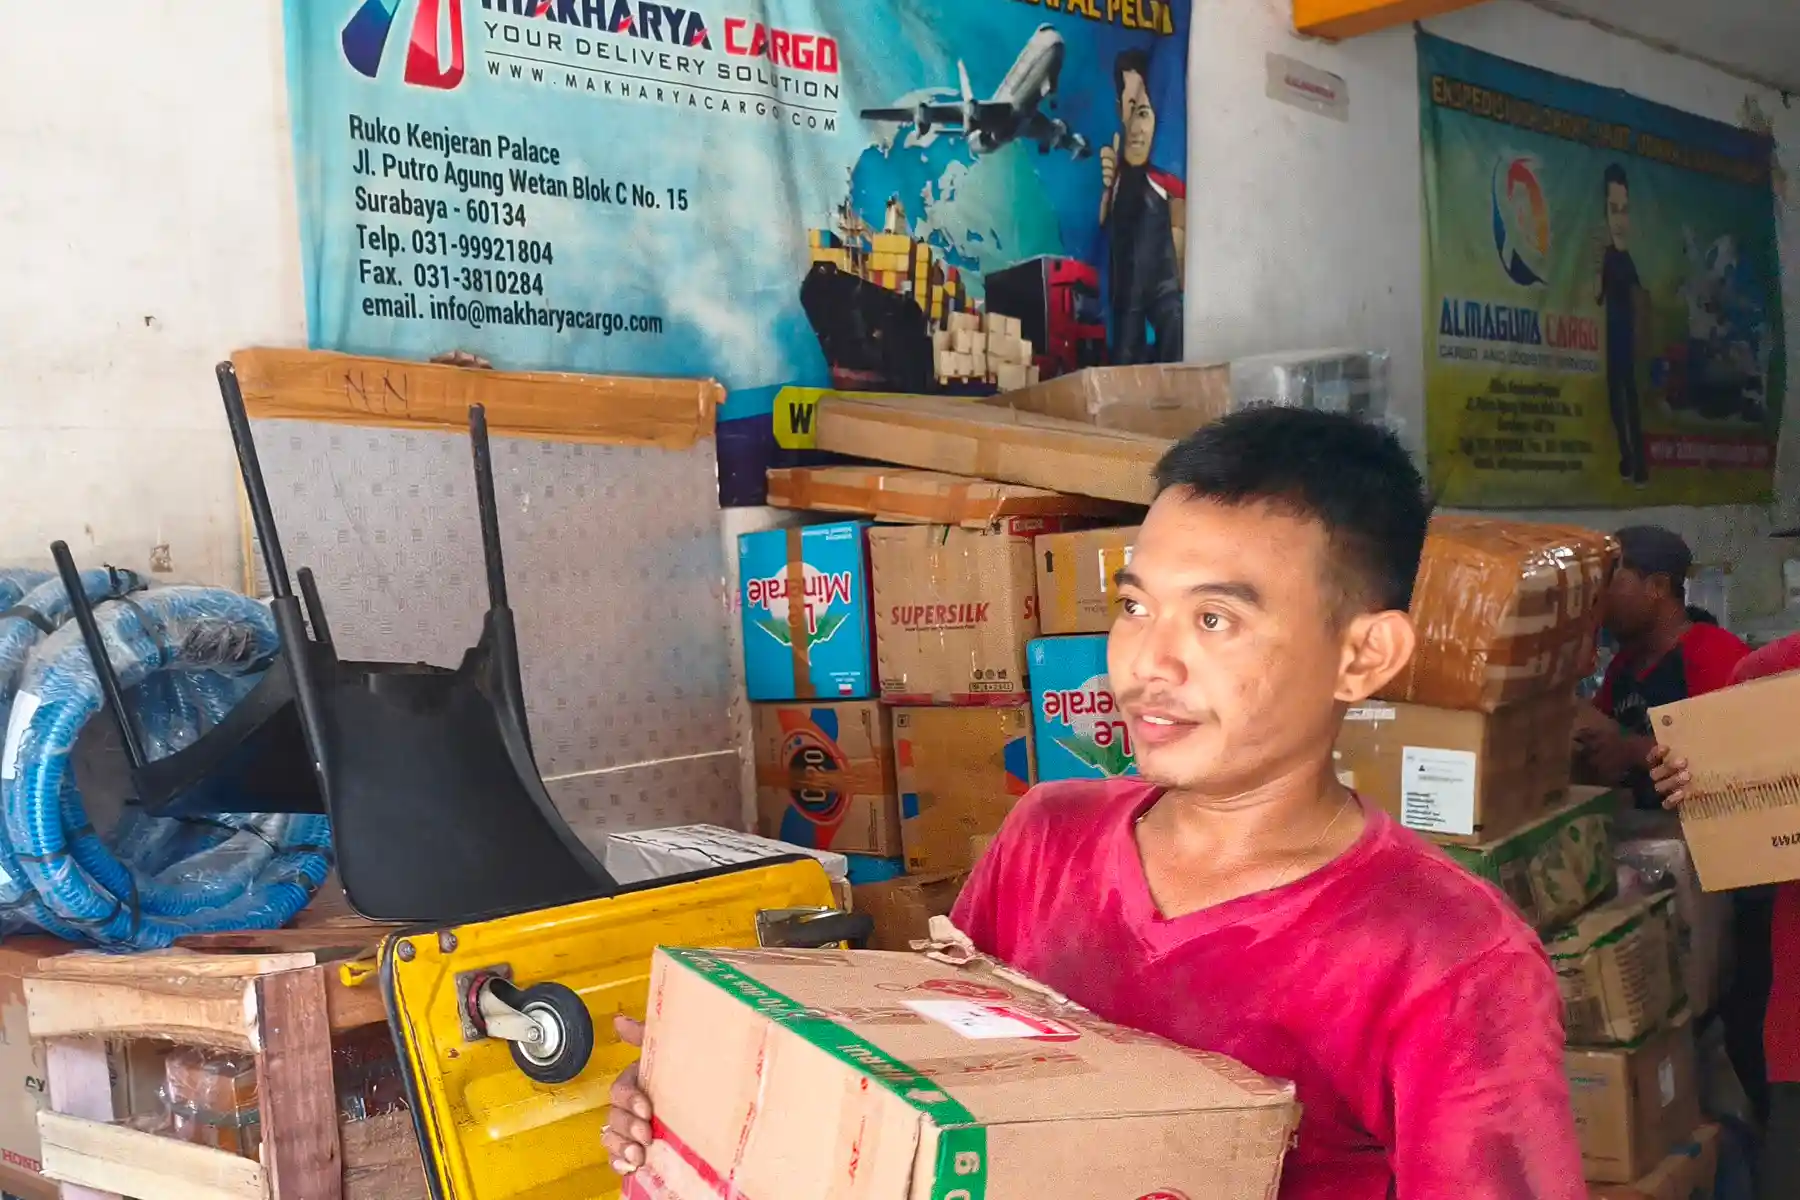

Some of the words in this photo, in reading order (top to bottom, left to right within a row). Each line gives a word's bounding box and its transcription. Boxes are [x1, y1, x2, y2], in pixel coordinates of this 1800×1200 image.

[484, 21, 562, 51] YOUR
[577, 38, 704, 75] DELIVERY
[717, 63, 839, 99] SOLUTION
[723, 17, 838, 73] CARGO
[487, 60, 836, 132] WWW.MAKHARYACARGOCOM
[349, 113, 401, 146] Ruko
[407, 122, 492, 158] Kenjeran
[497, 135, 560, 165] Palace
[353, 148, 376, 177] Jl.
[383, 153, 439, 183] Putro
[444, 160, 504, 197] Agung
[509, 168, 568, 198] Wetan
[572, 175, 612, 204] Blok
[615, 181, 627, 205] C
[632, 183, 660, 209] No.
[666, 188, 688, 211] 15
[355, 185, 448, 224] Surabaya
[466, 198, 526, 227] 60134
[356, 223, 406, 258] Telp.
[411, 230, 553, 265] 031-99921804
[359, 259, 403, 286] Fax.
[413, 263, 544, 296] 031-3810284
[362, 292, 424, 319] email.
[429, 294, 663, 336] info@makharyacargo.com
[891, 602, 990, 626] SUPERSILK
[1044, 690, 1120, 723] erale
[1, 1147, 42, 1173] HOND
